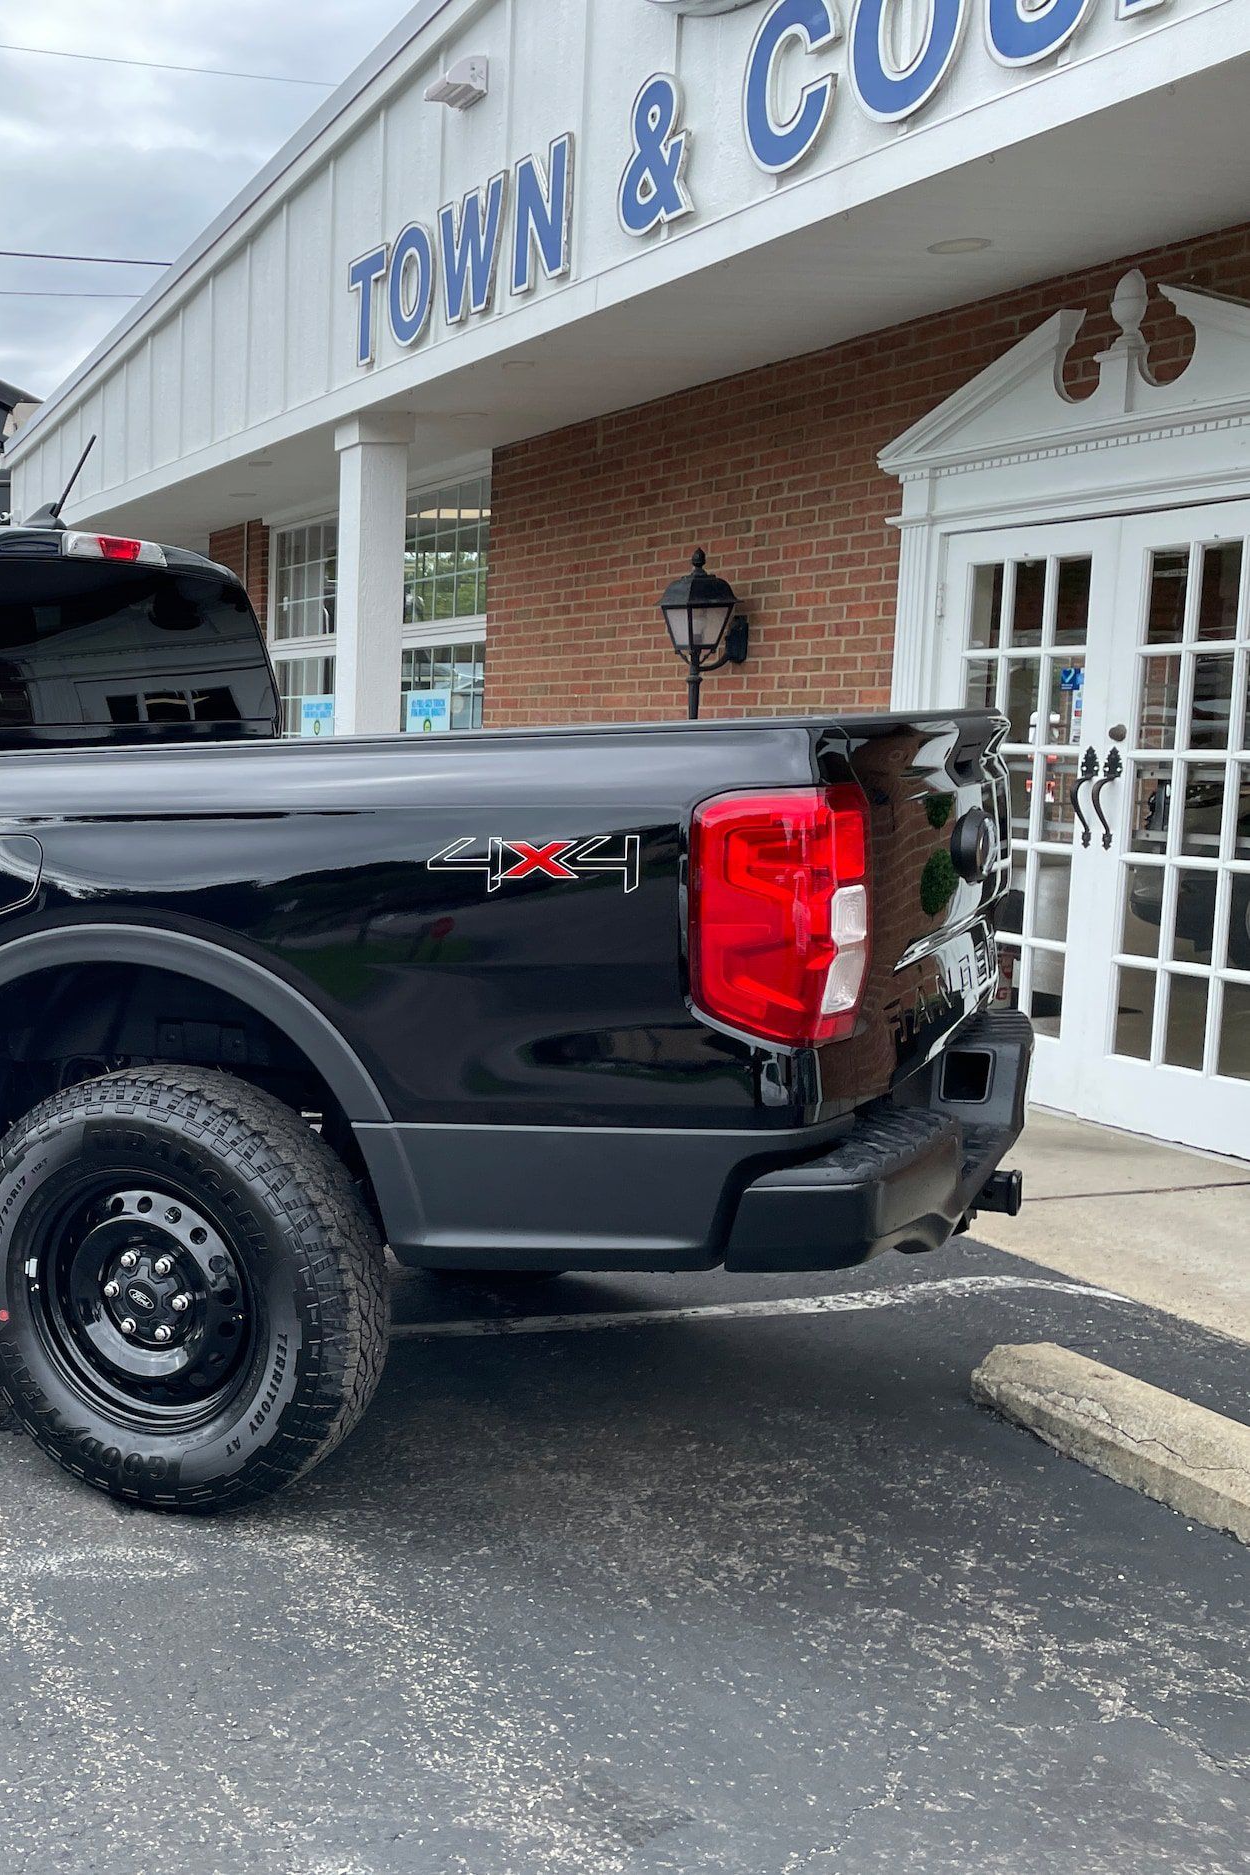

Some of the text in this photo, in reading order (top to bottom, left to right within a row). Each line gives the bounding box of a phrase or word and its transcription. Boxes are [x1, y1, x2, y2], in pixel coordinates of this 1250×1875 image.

[348, 0, 1184, 367] TOWN & CO
[131, 1290, 151, 1307] Ford
[225, 1333, 288, 1458] TERRITORY AT
